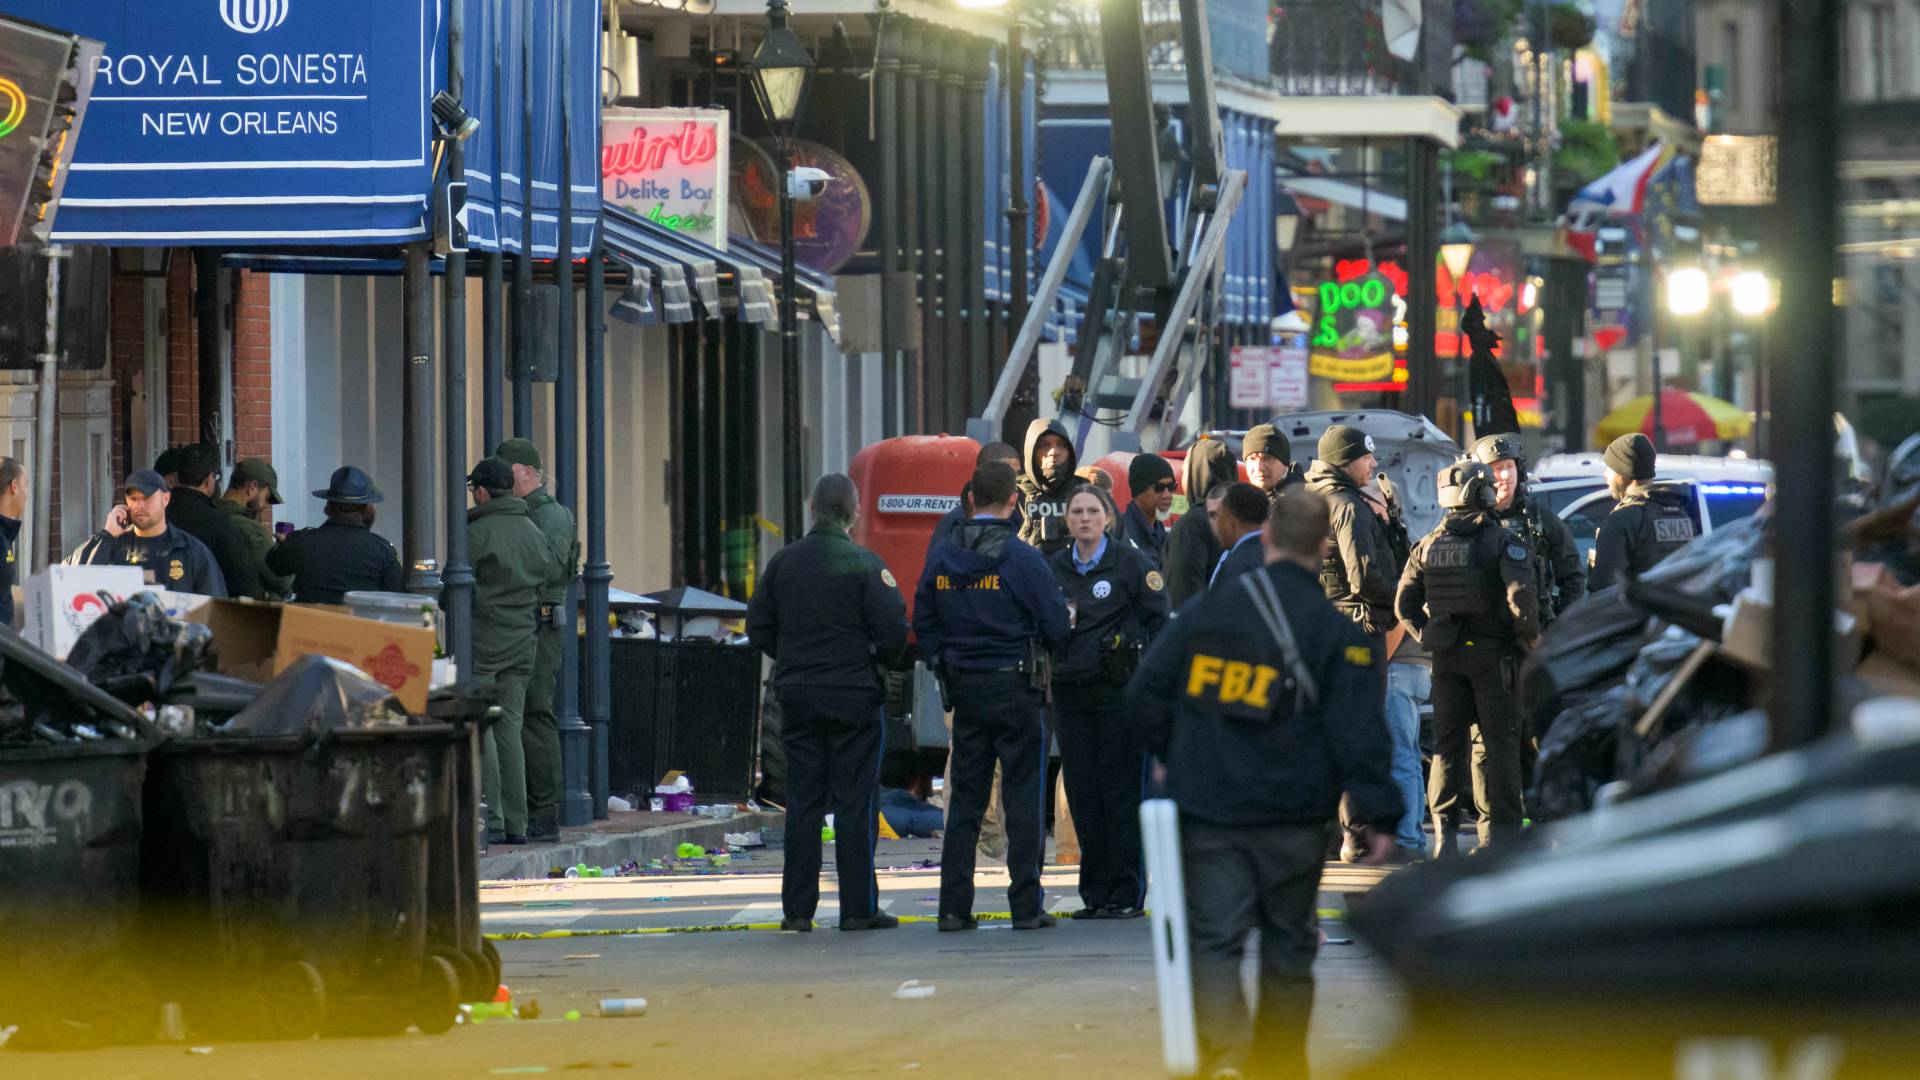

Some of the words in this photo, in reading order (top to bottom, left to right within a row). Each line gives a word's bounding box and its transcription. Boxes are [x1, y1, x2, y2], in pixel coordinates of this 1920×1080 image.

[89, 54, 222, 86] ROYAL
[236, 54, 367, 85] SONESTA
[142, 112, 211, 136] NEW
[220, 111, 337, 135] ORLEANS
[615, 178, 670, 200] Delite
[681, 178, 714, 200] Bar
[880, 498, 961, 510] 1-800-UR-RENTS
[1027, 502, 1067, 518] POLI
[1428, 550, 1469, 568] OLICE
[936, 575, 1000, 590] DEIVE
[1186, 654, 1280, 709] FBI
